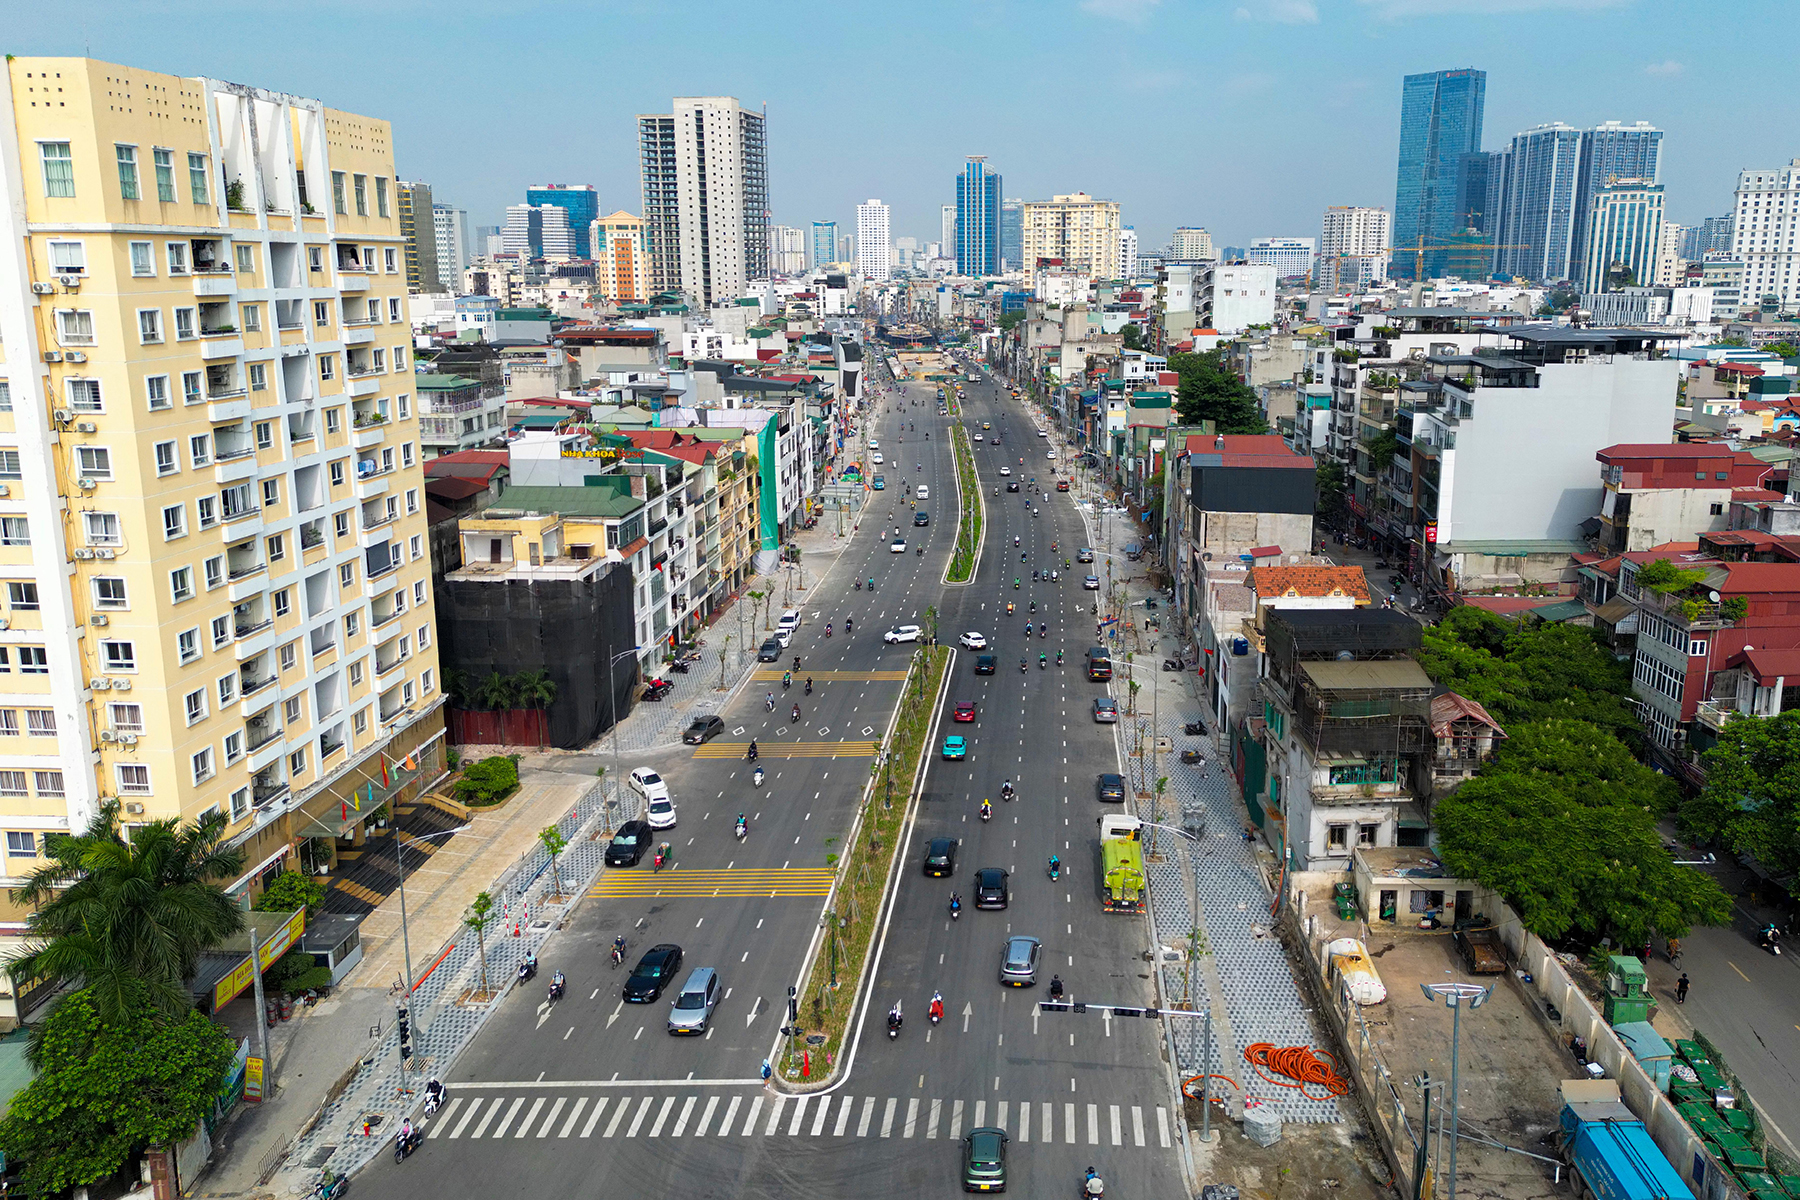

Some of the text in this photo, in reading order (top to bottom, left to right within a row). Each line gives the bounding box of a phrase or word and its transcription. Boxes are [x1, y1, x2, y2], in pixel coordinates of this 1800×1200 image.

[585, 450, 616, 458] KHOA
[616, 448, 645, 458] Rose
[18, 976, 43, 998] BIA
